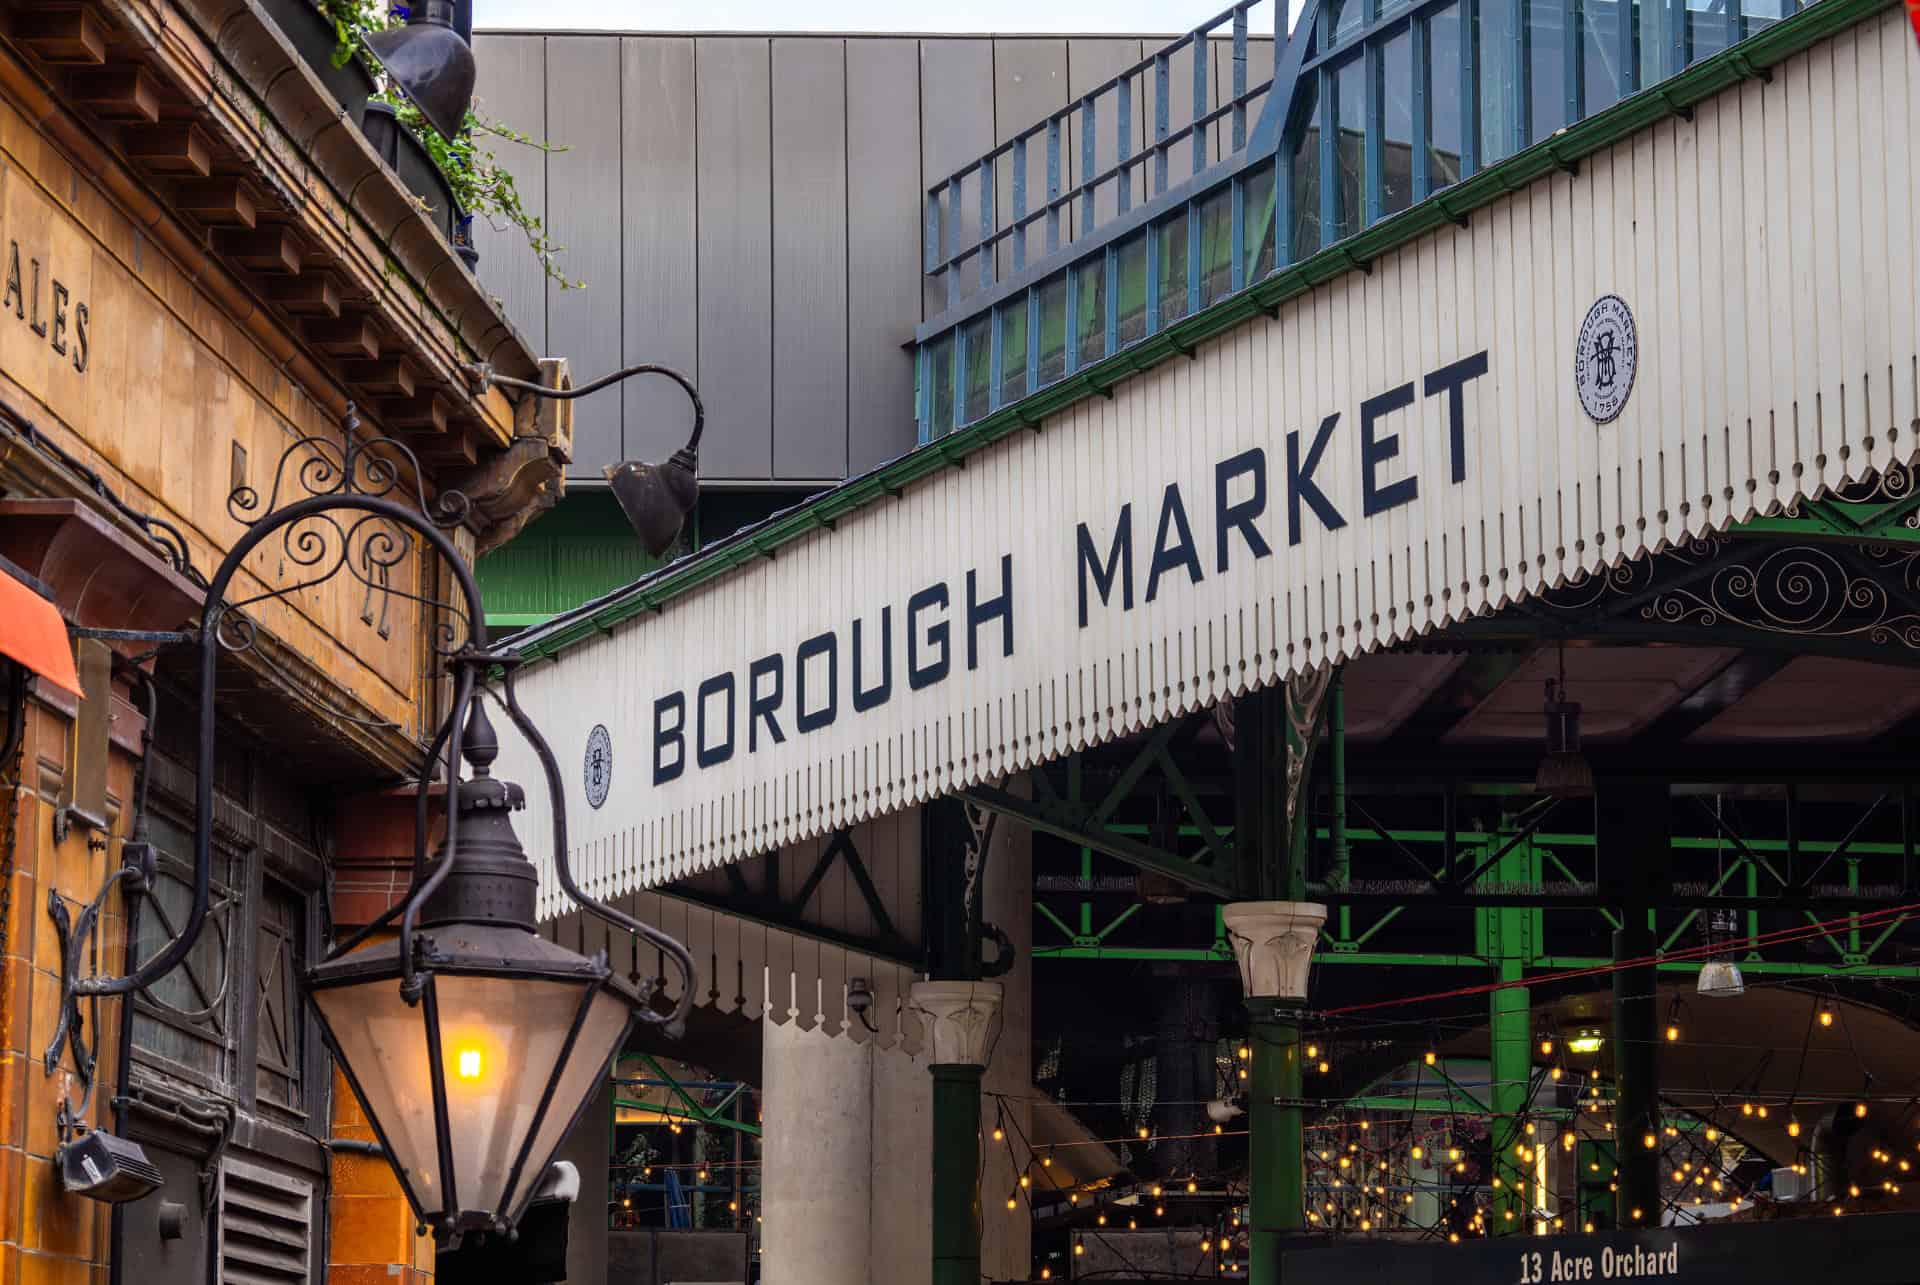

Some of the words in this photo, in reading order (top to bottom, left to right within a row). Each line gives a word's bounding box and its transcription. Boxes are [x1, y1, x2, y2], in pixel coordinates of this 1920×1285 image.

[4, 239, 89, 373] ALES
[652, 553, 1014, 787] BOROUGH
[1076, 350, 1489, 629] MARKET
[1520, 1252, 1543, 1284] 13
[1550, 1250, 1593, 1282] Acre
[1601, 1242, 1678, 1278] Orchard
